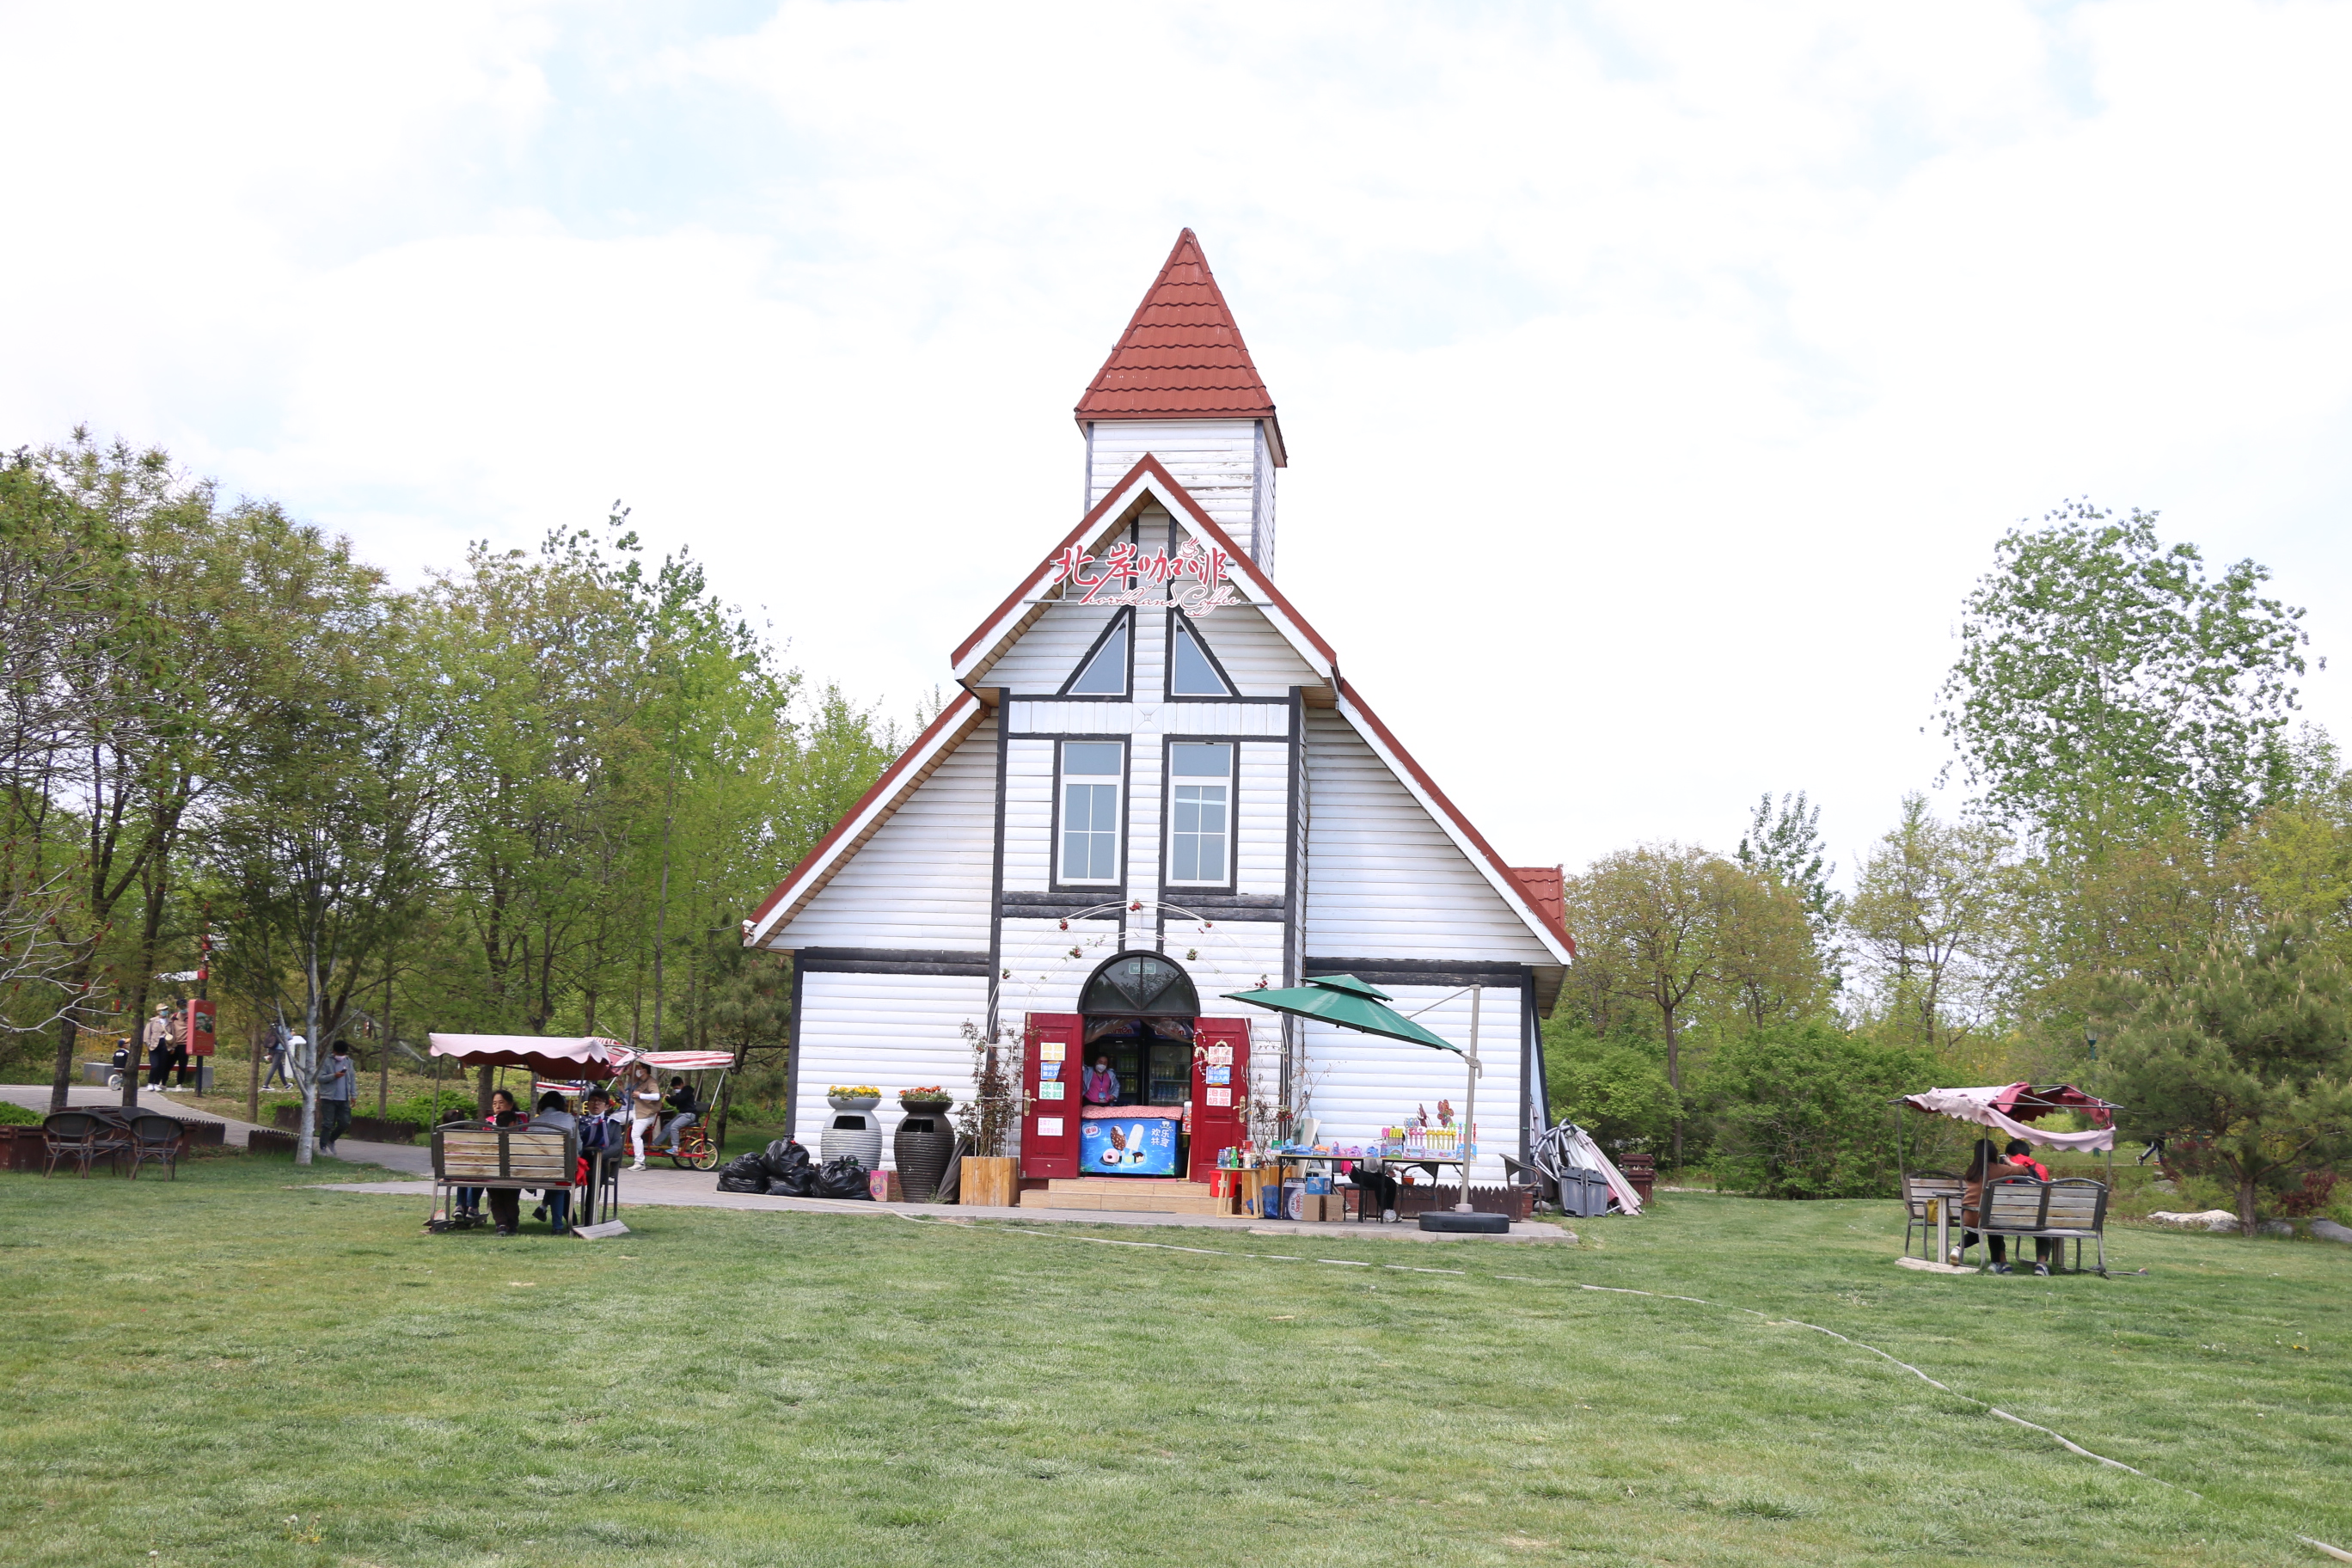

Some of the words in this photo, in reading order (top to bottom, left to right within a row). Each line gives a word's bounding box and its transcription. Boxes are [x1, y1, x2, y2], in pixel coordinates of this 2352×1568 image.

[1053, 543, 1229, 591] 北岸咖啡
[1180, 585, 1241, 617] Coffee
[1208, 1088, 1230, 1097] 泡面
[1208, 1097, 1230, 1106] 奶茶
[1151, 1128, 1170, 1138] 欢乐
[1151, 1137, 1170, 1147] 共享
